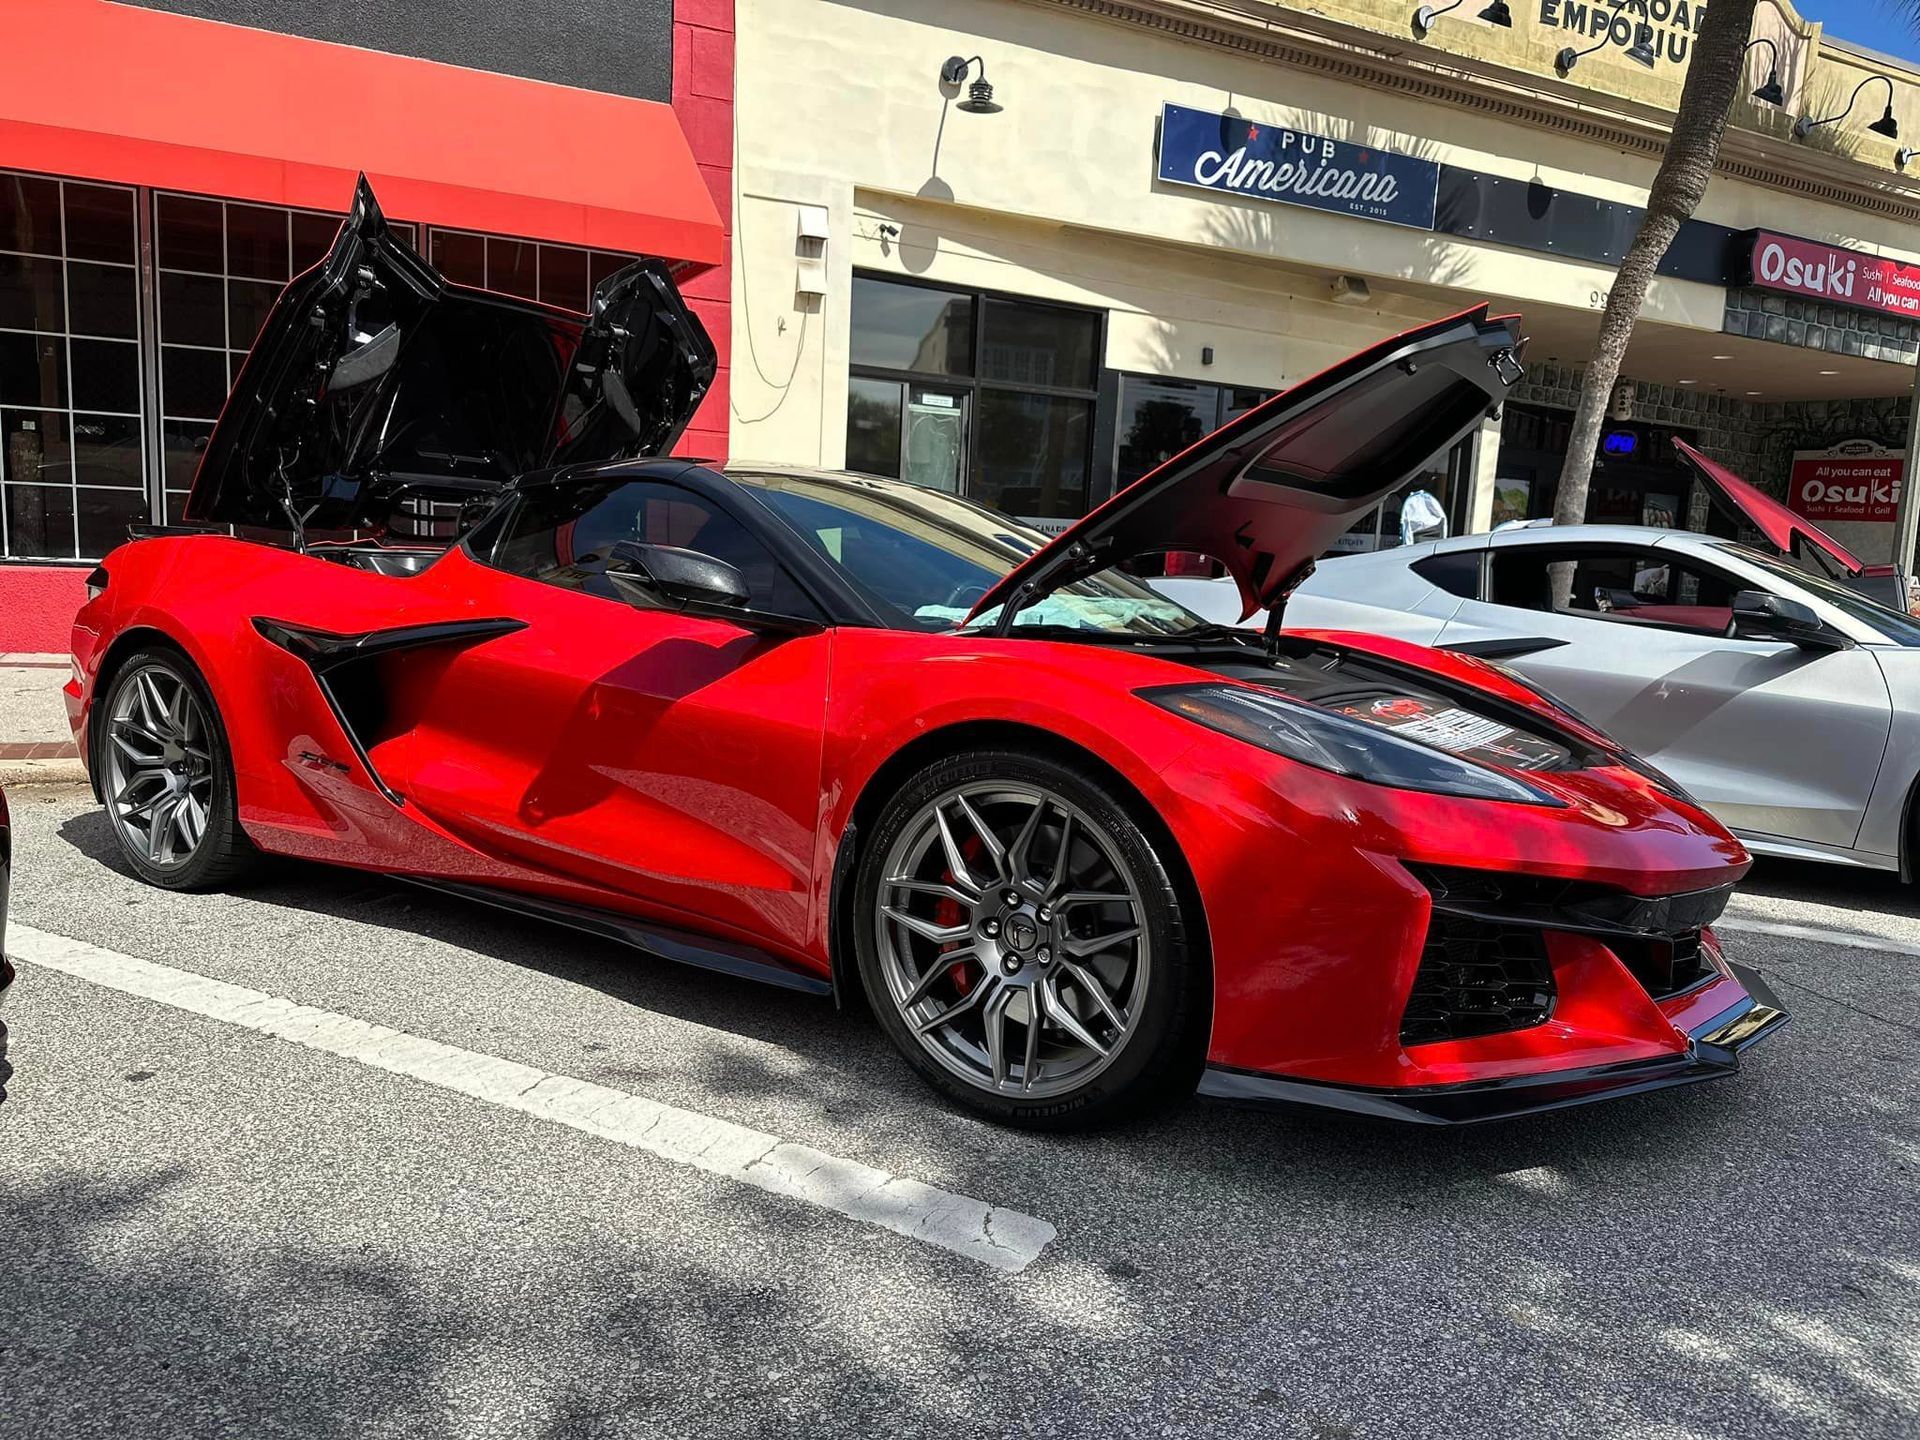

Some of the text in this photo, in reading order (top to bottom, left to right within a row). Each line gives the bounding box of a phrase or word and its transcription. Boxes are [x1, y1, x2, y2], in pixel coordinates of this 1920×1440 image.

[1539, 0, 1698, 63] EMPORIU
[1282, 131, 1336, 159] PUB
[1194, 147, 1399, 203] Americana
[1760, 243, 1856, 297] Osuki
[1862, 266, 1883, 281] Sushi
[1867, 286, 1919, 311] All you can
[1816, 467, 1891, 478] All you can eat
[1801, 479, 1901, 505] Osuki
[1834, 506, 1864, 514] Seafood
[1874, 507, 1890, 515] Grill
